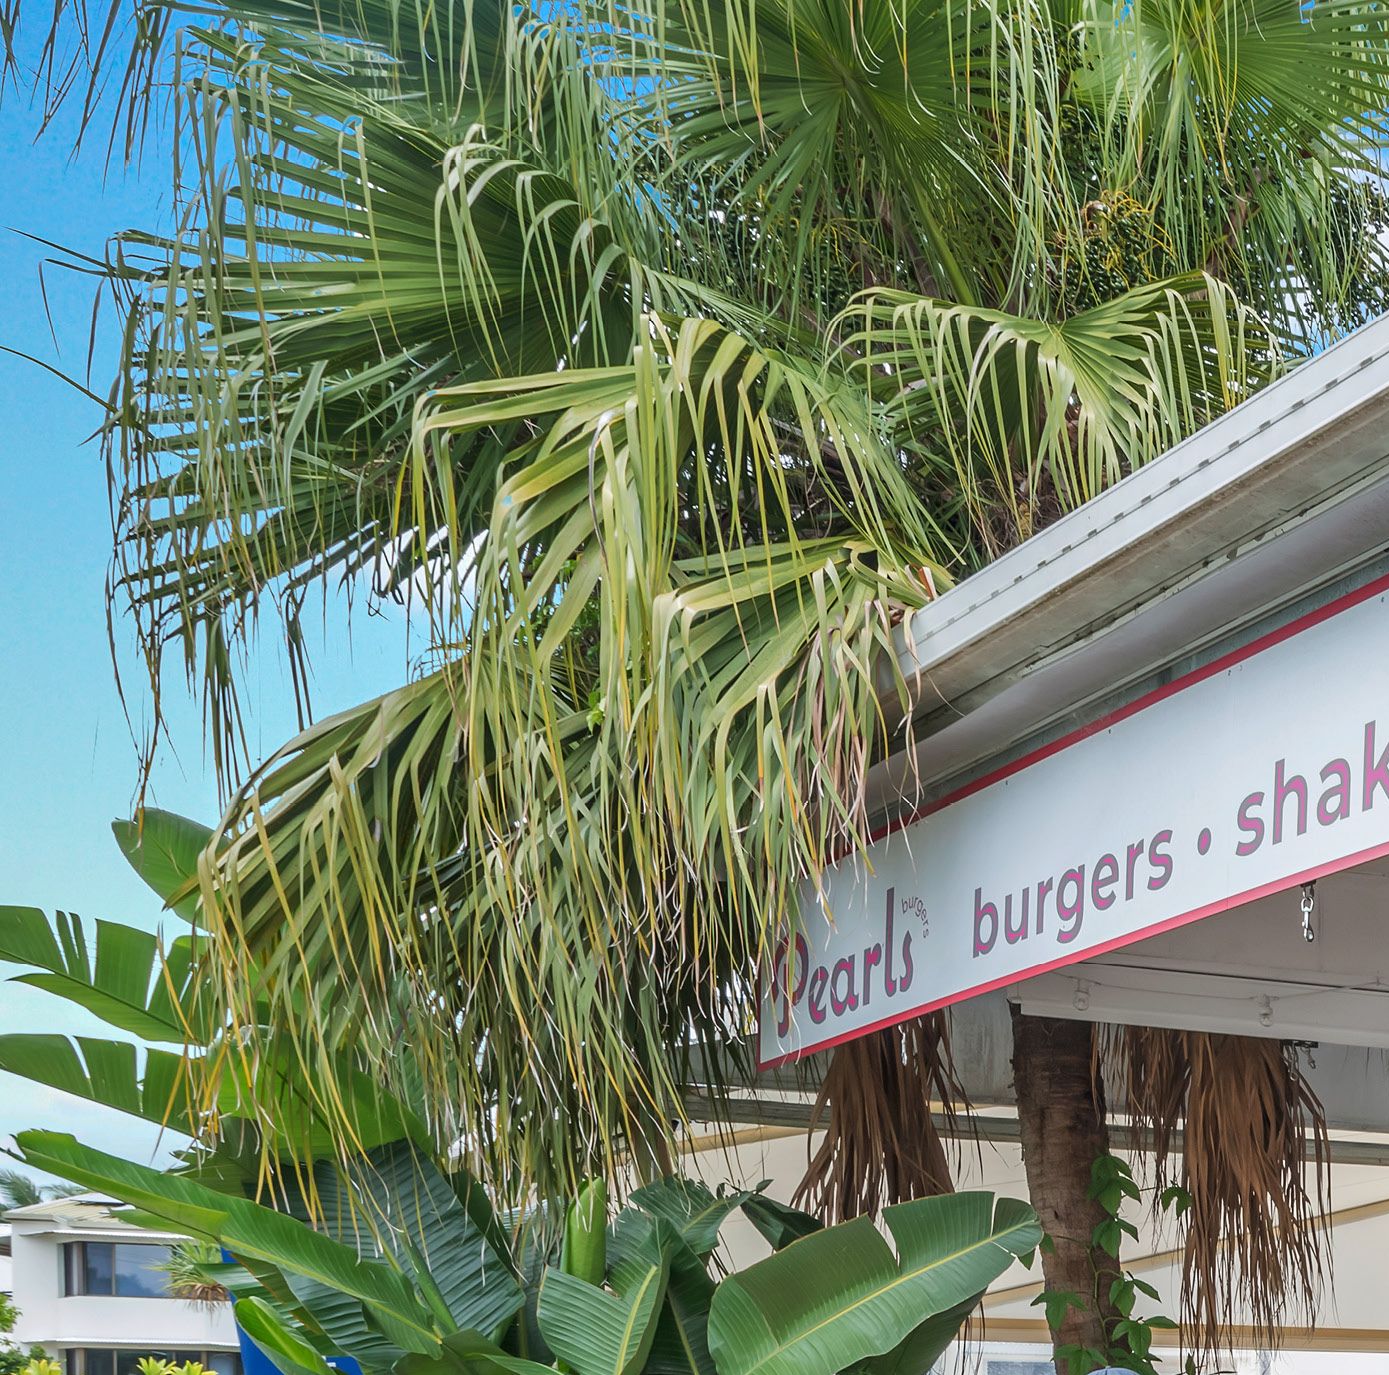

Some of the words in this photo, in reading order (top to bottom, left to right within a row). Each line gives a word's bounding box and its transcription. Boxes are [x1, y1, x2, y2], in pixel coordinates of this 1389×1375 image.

[772, 886, 914, 1039] Pearls
[972, 828, 1174, 958] burgers
[901, 896, 930, 939] burgers
